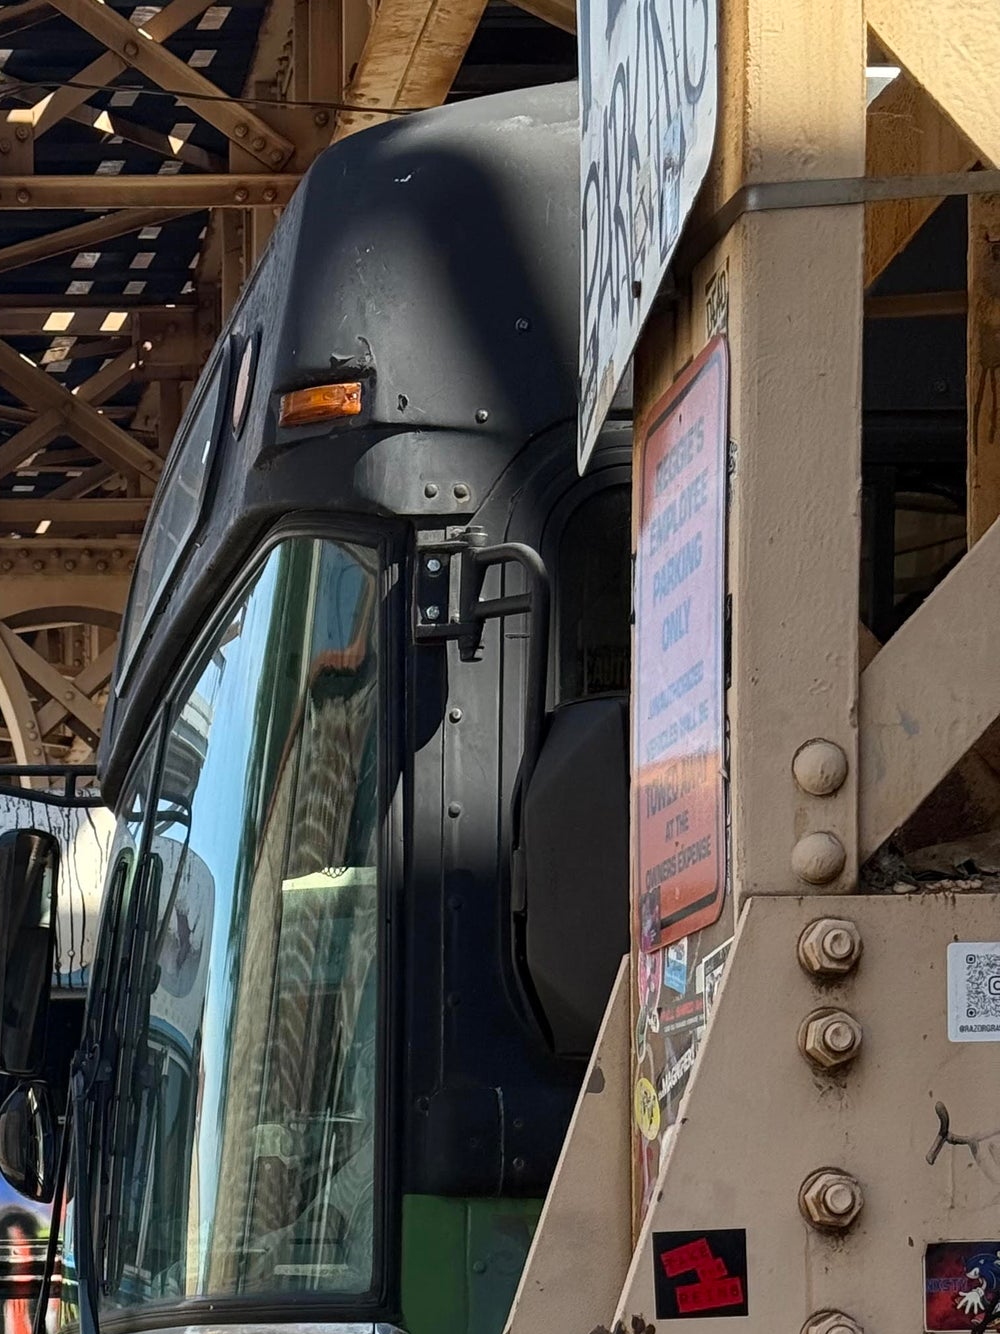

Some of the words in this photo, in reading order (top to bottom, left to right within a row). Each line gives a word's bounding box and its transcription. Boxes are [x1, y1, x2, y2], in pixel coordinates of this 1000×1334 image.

[650, 466, 709, 557] EMPLOYEE
[653, 530, 702, 608] PARKING
[662, 597, 691, 652] ONLY
[665, 818, 675, 843] AT
[676, 809, 689, 837] THE
[677, 835, 711, 876] EXPENSE
